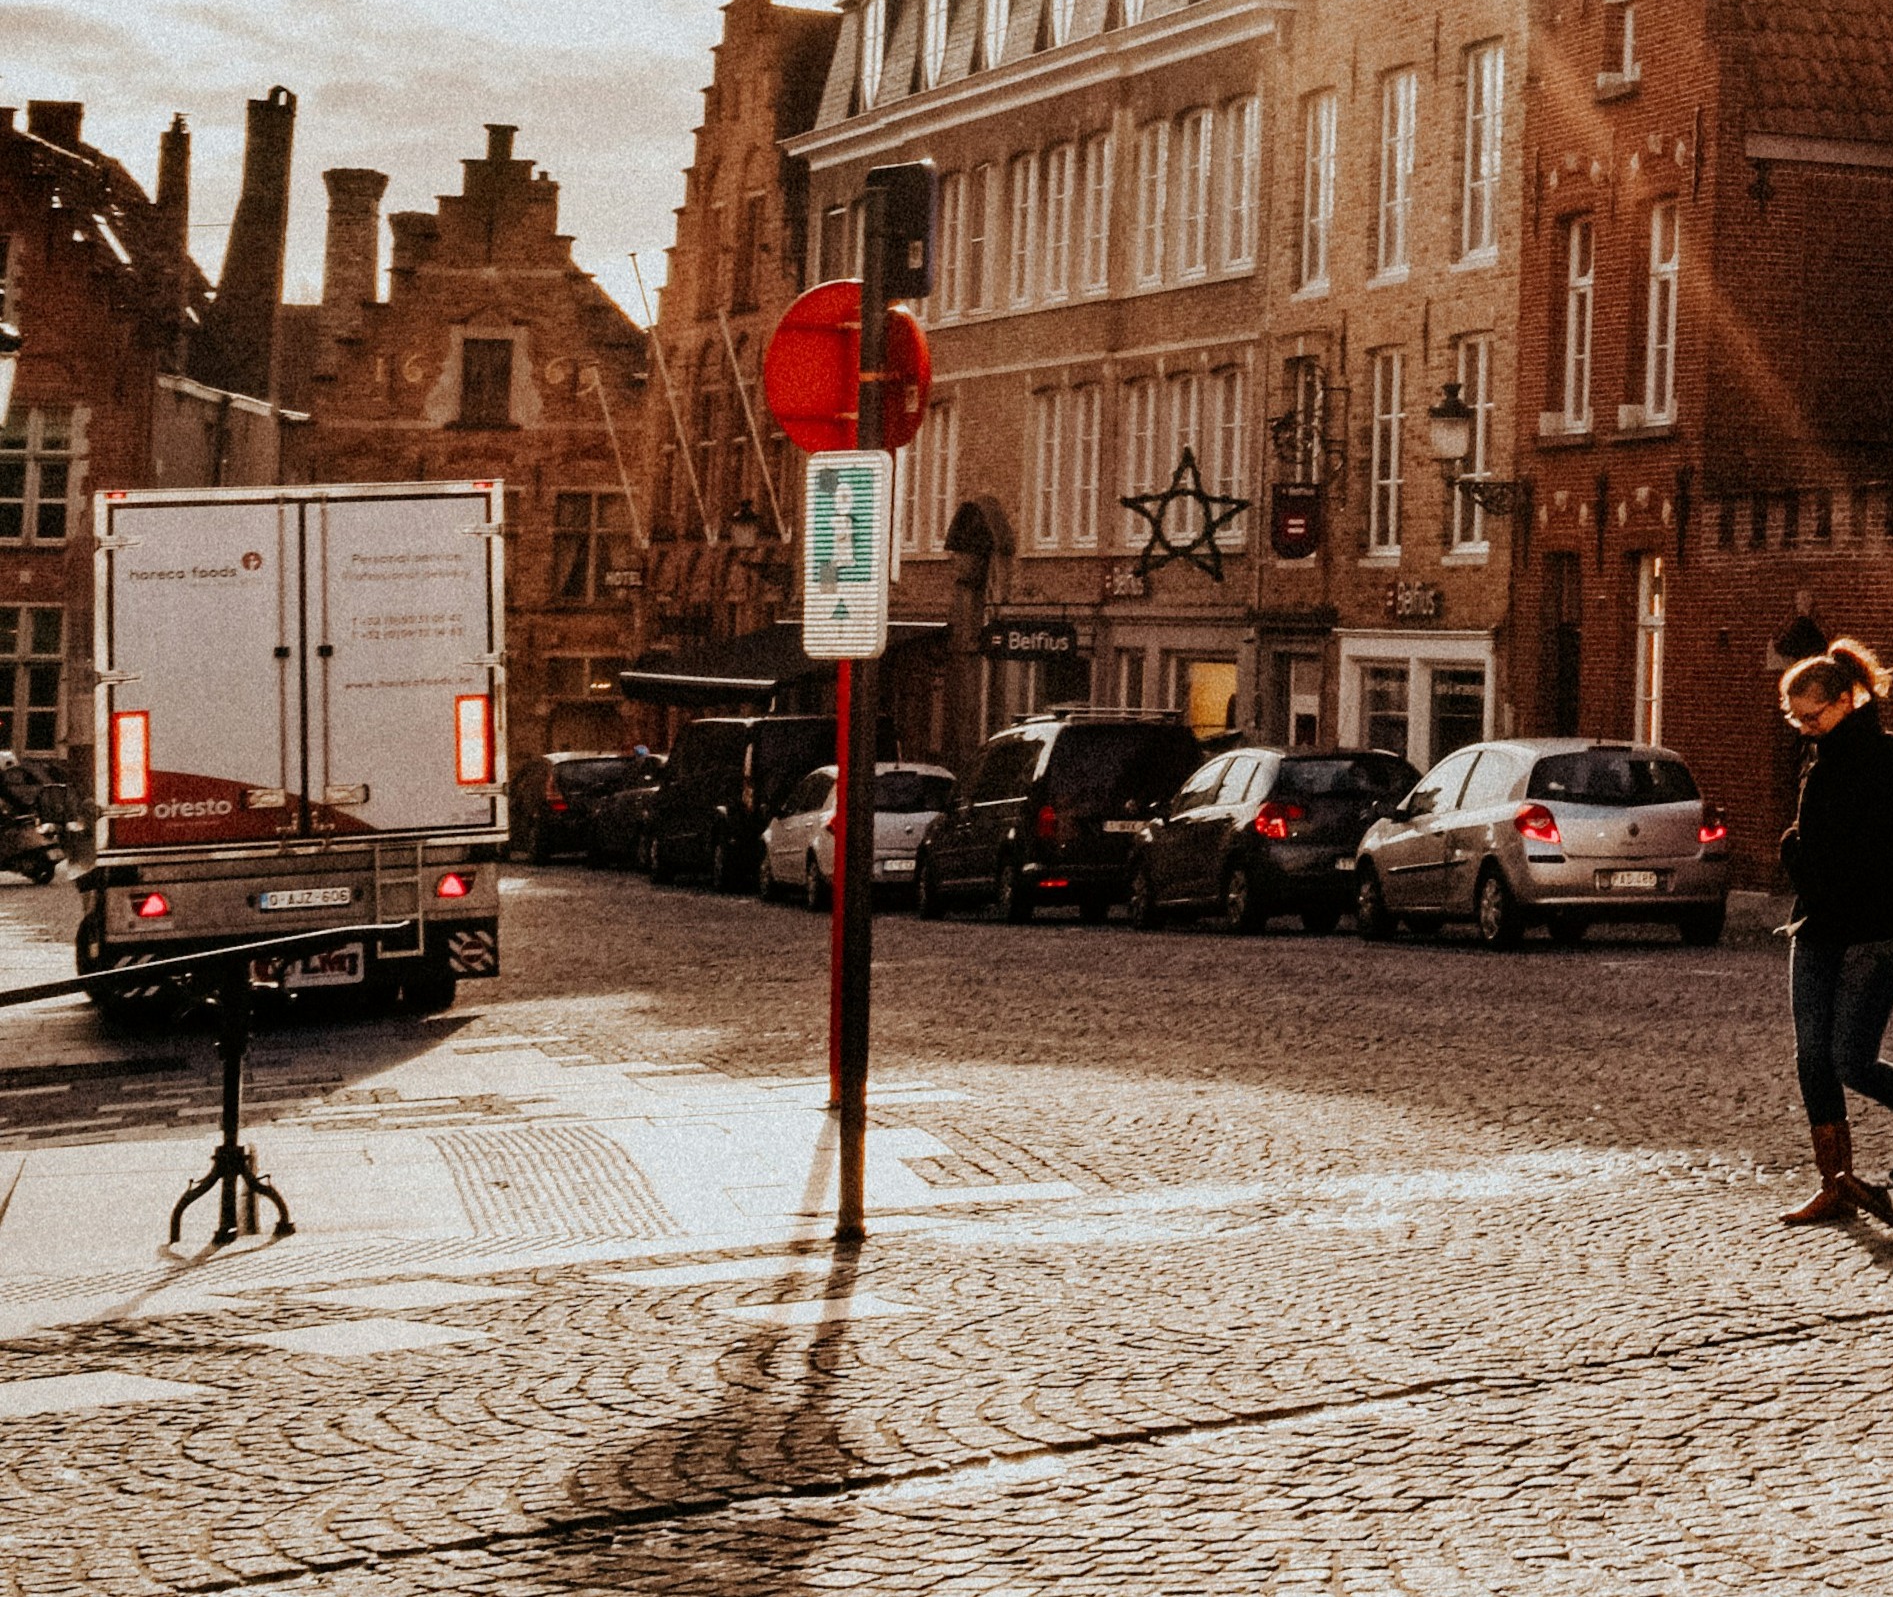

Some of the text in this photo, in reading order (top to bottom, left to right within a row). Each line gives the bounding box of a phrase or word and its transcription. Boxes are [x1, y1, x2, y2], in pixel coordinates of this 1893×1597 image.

[129, 565, 238, 582] horeca foods
[1008, 631, 1069, 651] Belfius
